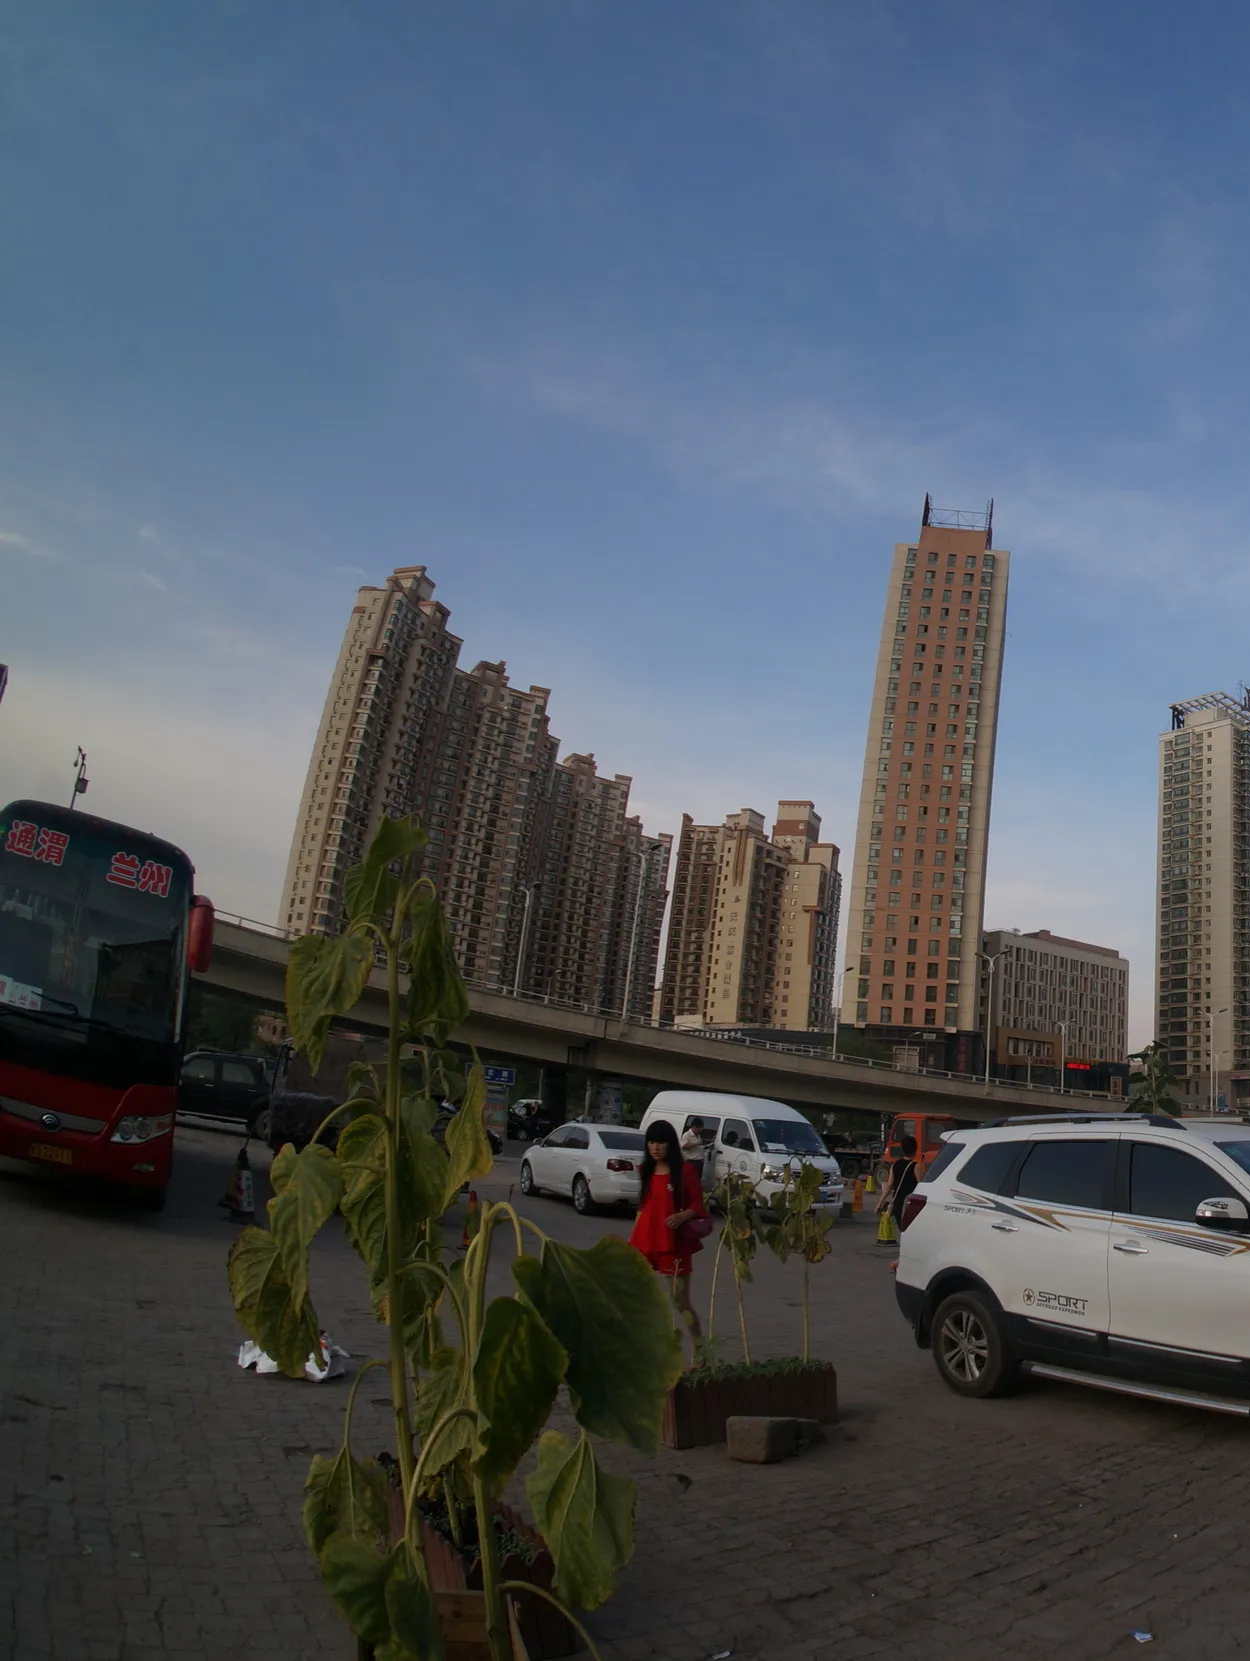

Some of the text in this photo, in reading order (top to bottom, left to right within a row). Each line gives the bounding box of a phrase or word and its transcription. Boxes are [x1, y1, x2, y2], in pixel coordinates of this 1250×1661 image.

[4, 819, 174, 898] 通渭 兰州
[1037, 1291, 1088, 1310] SPORT
